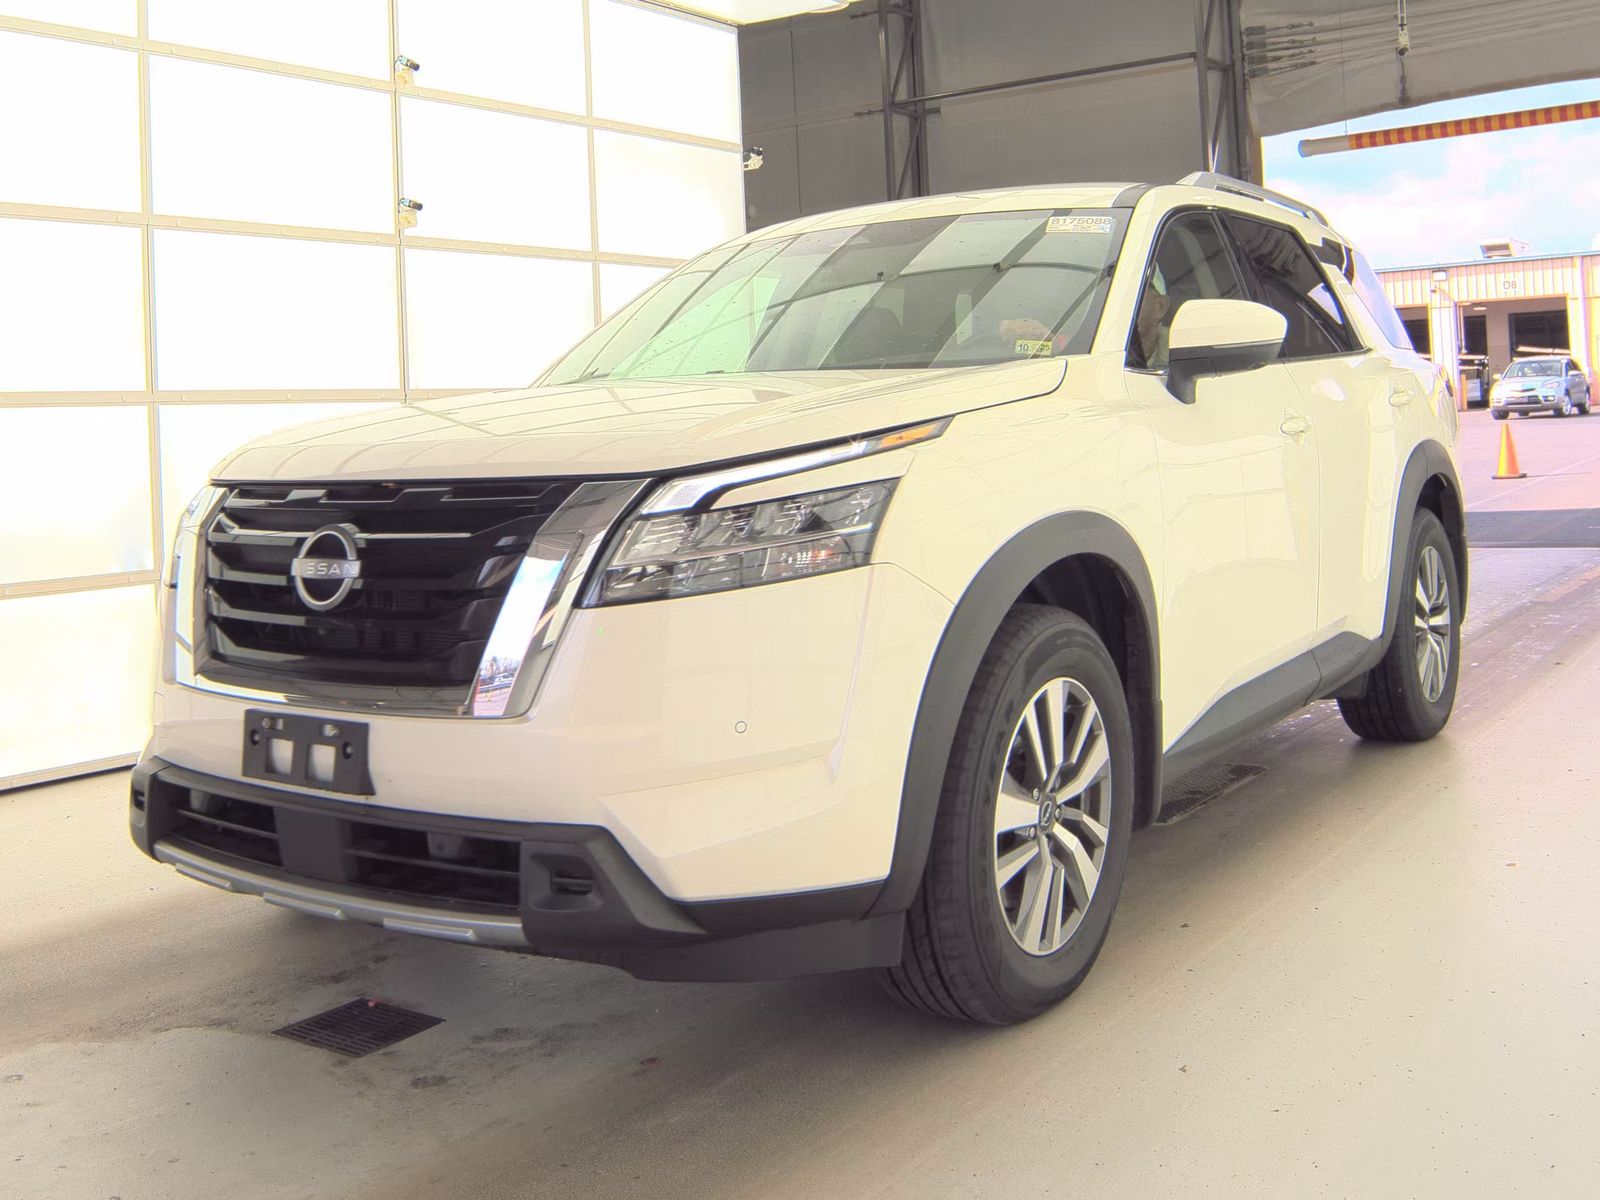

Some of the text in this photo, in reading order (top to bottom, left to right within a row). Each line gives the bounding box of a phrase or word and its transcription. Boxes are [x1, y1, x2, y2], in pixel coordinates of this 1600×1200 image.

[1051, 217, 1111, 225] 8175088
[1018, 343, 1029, 352] 10
[295, 562, 357, 575] SSAN
